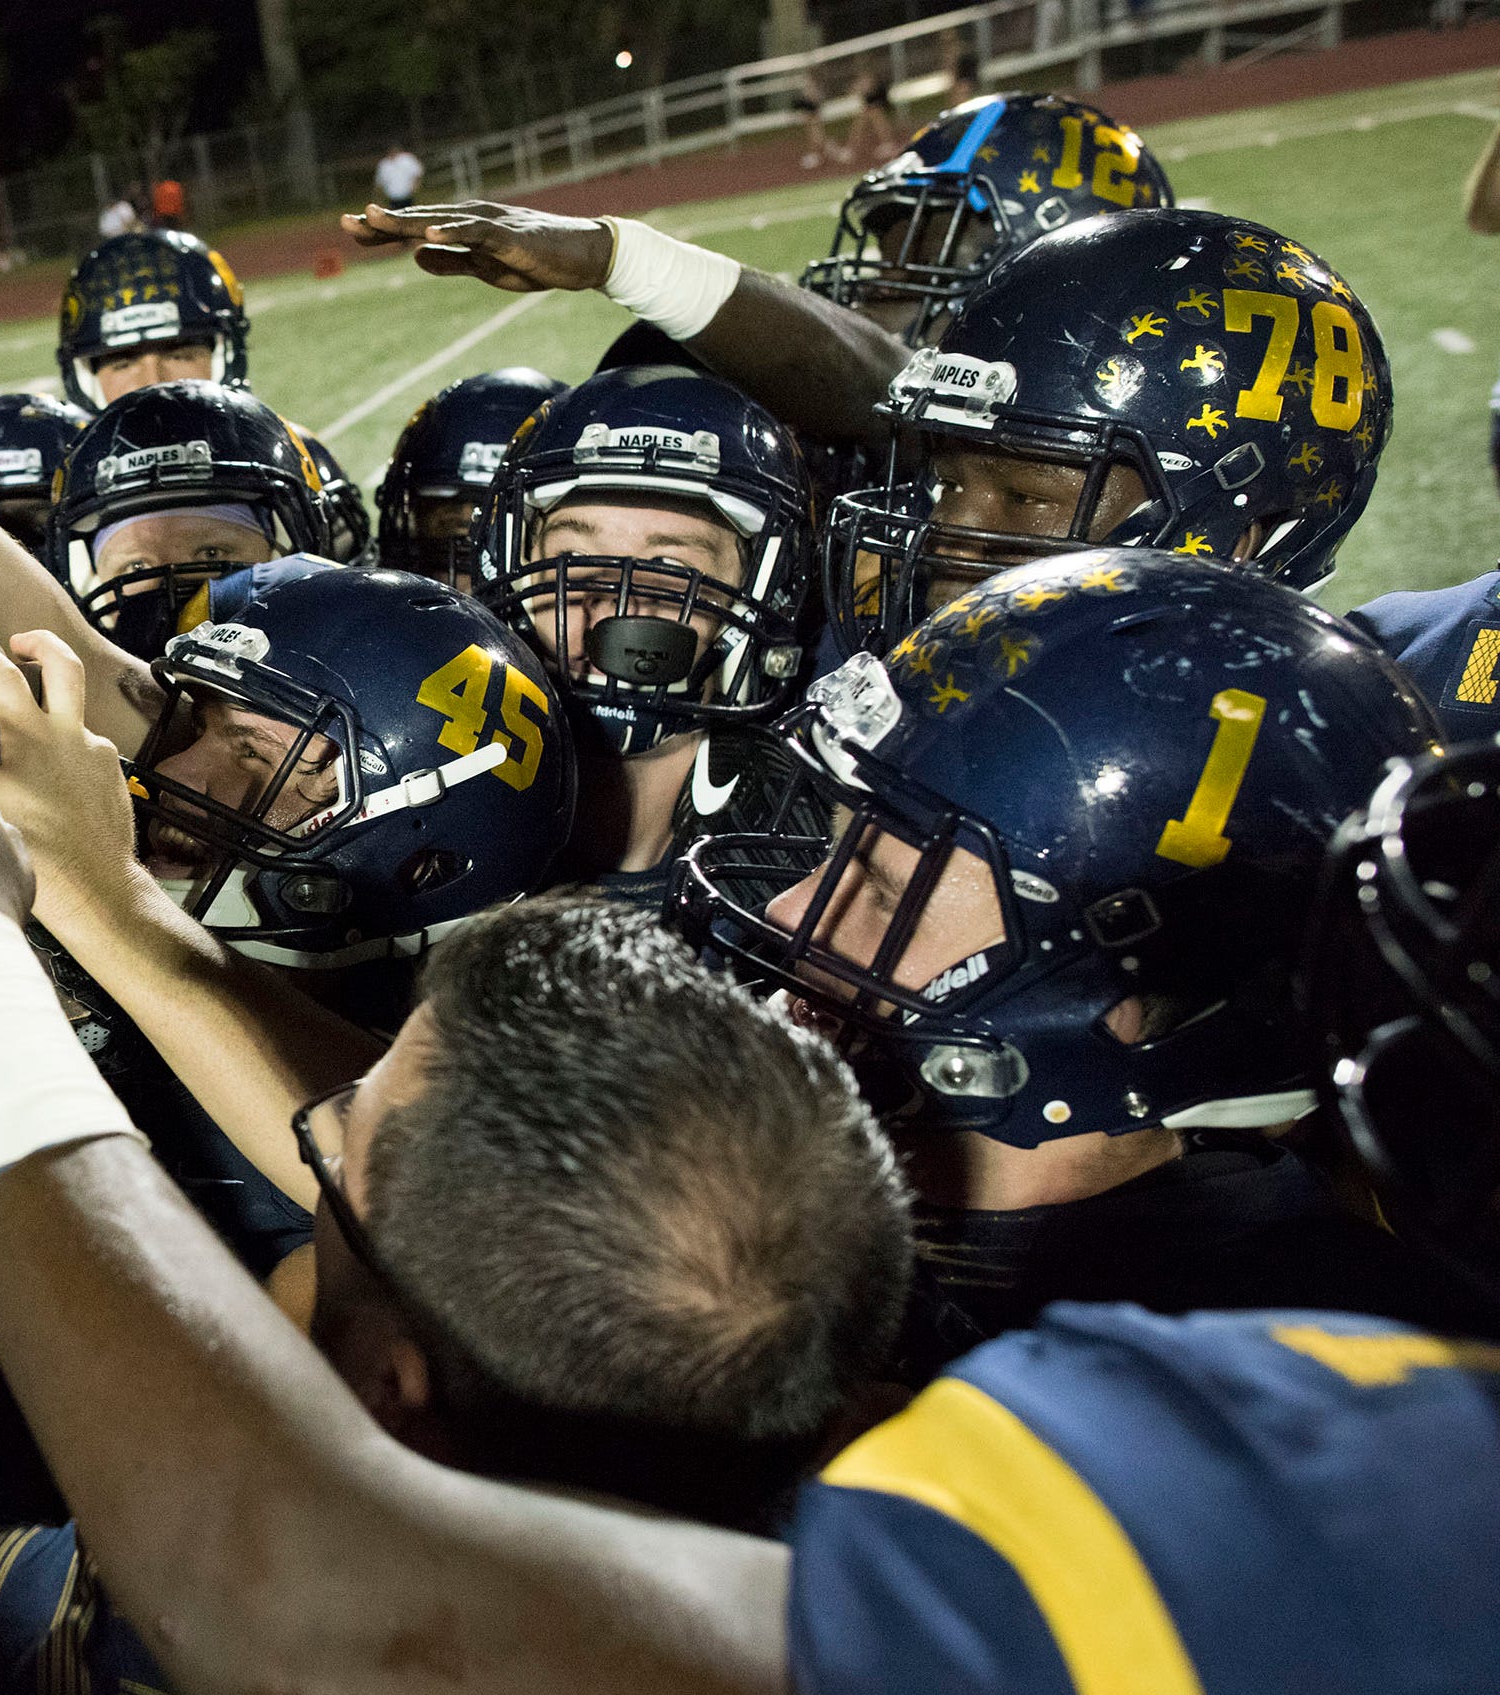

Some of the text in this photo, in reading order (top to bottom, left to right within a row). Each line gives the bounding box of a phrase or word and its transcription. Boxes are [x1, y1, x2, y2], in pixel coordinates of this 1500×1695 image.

[1051, 115, 1141, 208] 12
[931, 363, 980, 388] NAPLES
[1223, 288, 1363, 432] 78
[128, 449, 180, 468] NAPLES
[618, 434, 683, 448] NAPLES
[1159, 457, 1192, 468] PEED
[417, 643, 549, 792] 45
[1156, 688, 1267, 869] 1
[923, 952, 990, 1001] ddell
